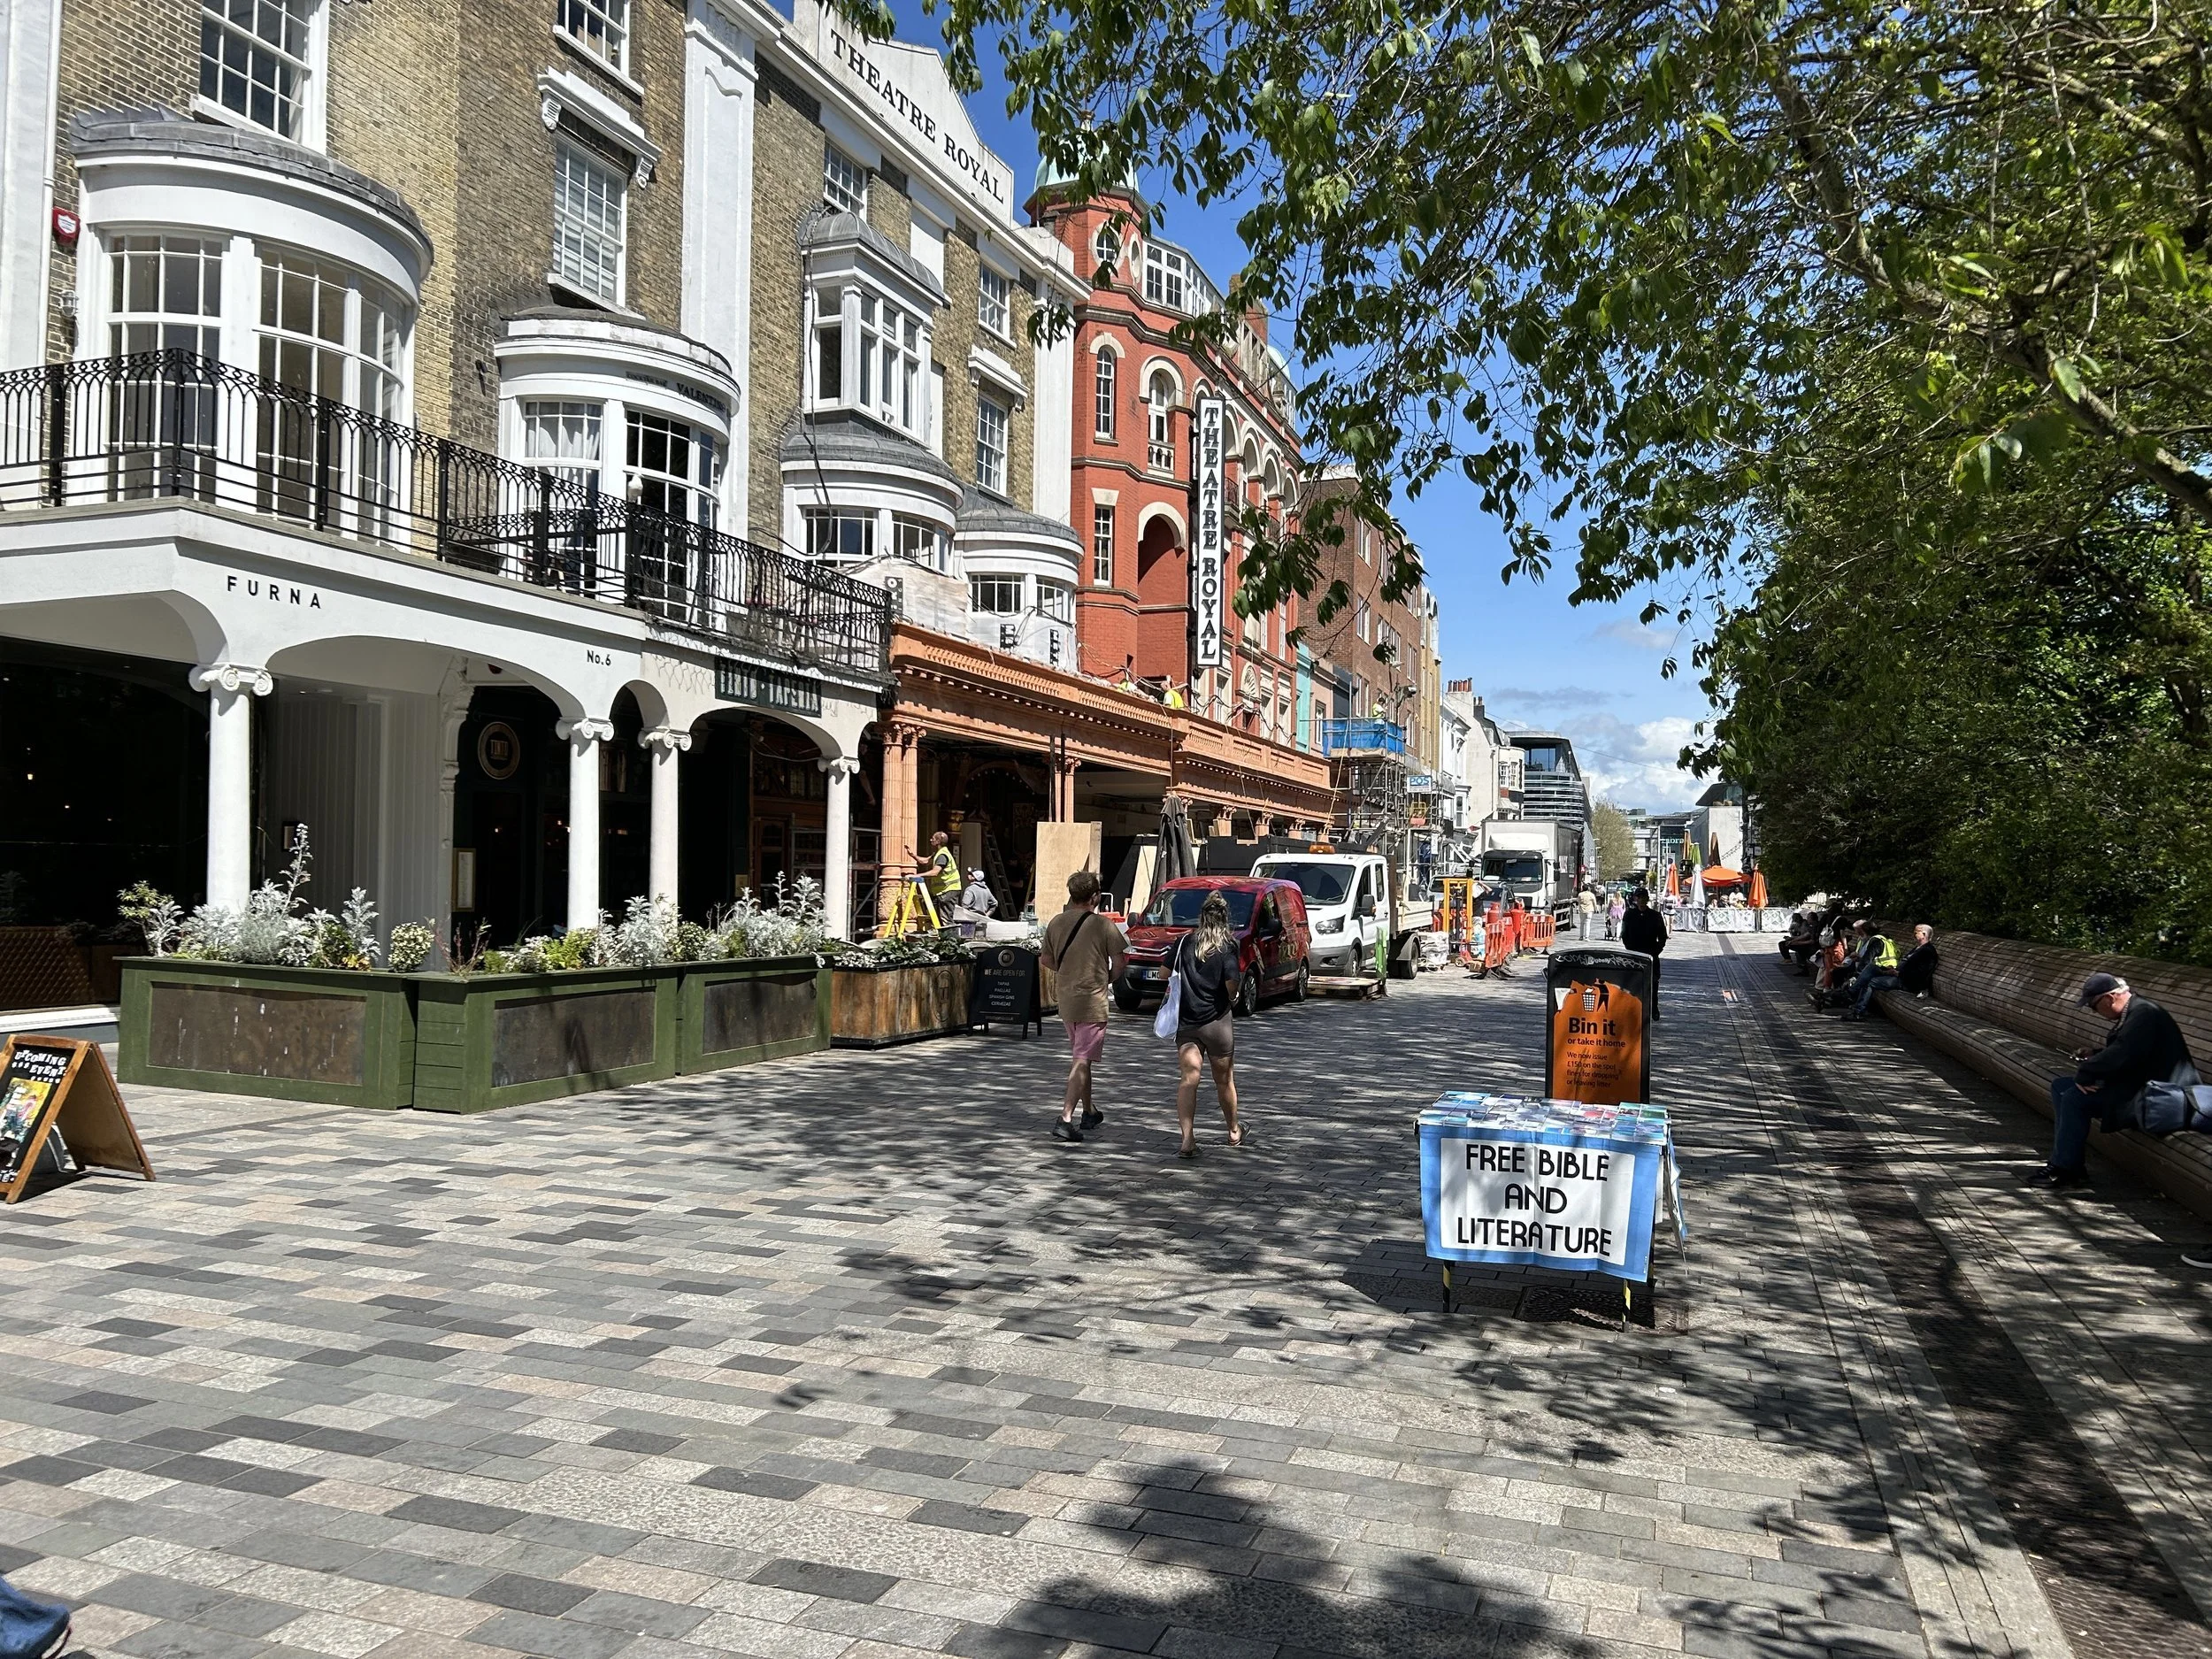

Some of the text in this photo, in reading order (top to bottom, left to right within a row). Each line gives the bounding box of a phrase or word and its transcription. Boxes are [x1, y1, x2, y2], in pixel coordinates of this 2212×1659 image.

[831, 29, 1004, 204] THEATRE ROYAL
[1202, 407, 1220, 550] THEATRE
[227, 574, 321, 610] FURNA
[1202, 557, 1217, 659] ROYAL
[587, 649, 611, 666] No.6
[1409, 777, 1430, 786] POS
[1016, 969, 1025, 978] FOR
[1569, 1017, 1616, 1036] Bin it
[14, 1049, 67, 1066] UPCOMING
[1577, 1037, 1594, 1046] take
[1602, 1038, 1626, 1048] home
[1465, 1143, 1609, 1182] FREE BIBLE
[1504, 1183, 1568, 1214] AND
[1457, 1217, 1612, 1256] LITERATURE
